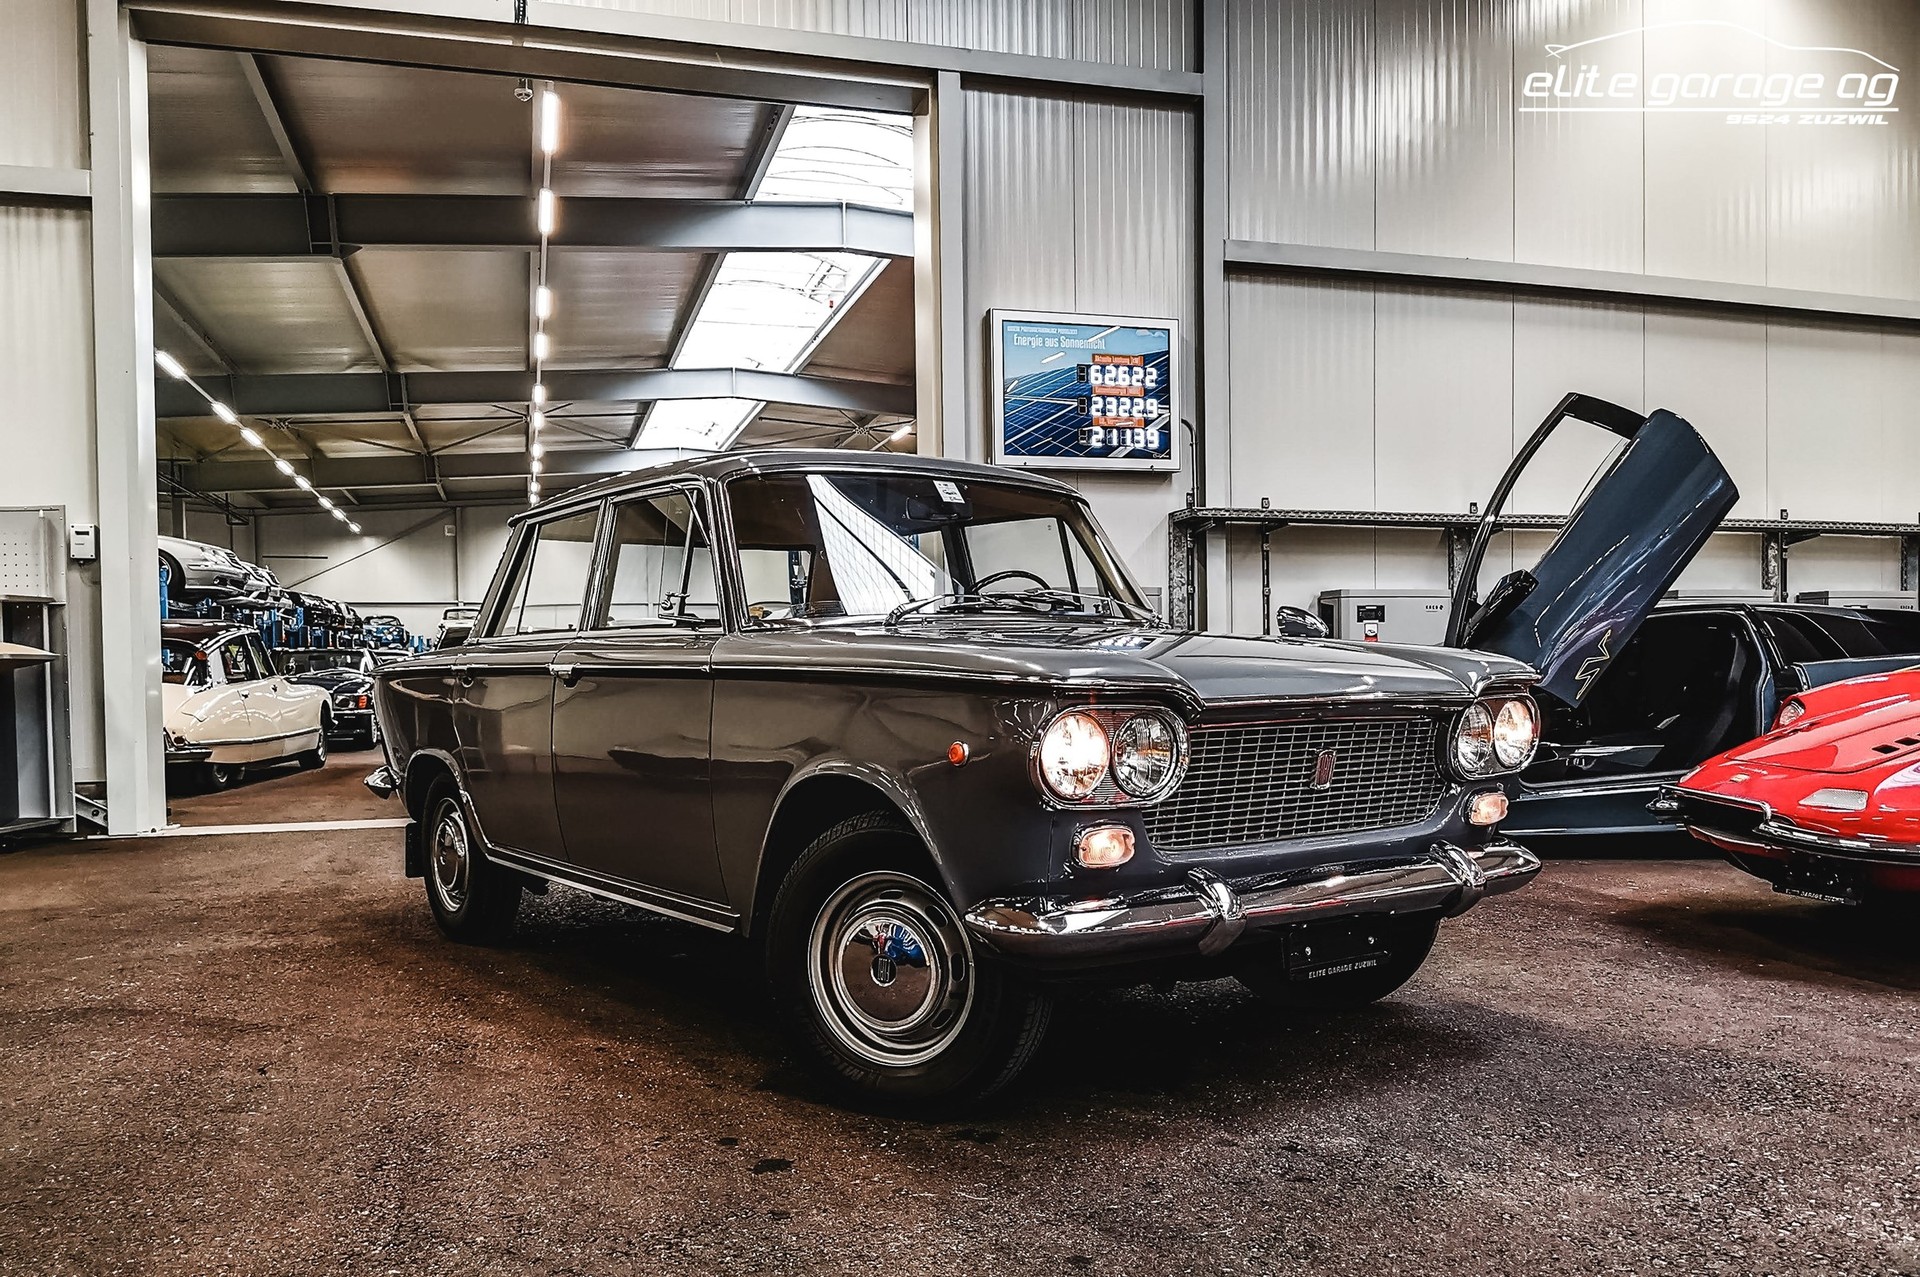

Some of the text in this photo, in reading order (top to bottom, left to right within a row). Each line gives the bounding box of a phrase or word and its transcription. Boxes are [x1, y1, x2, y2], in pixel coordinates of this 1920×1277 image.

[1013, 334, 1043, 348] Energie
[1045, 337, 1059, 347] aus
[1308, 968, 1326, 979] ELITE
[1328, 963, 1353, 975] GARAGE
